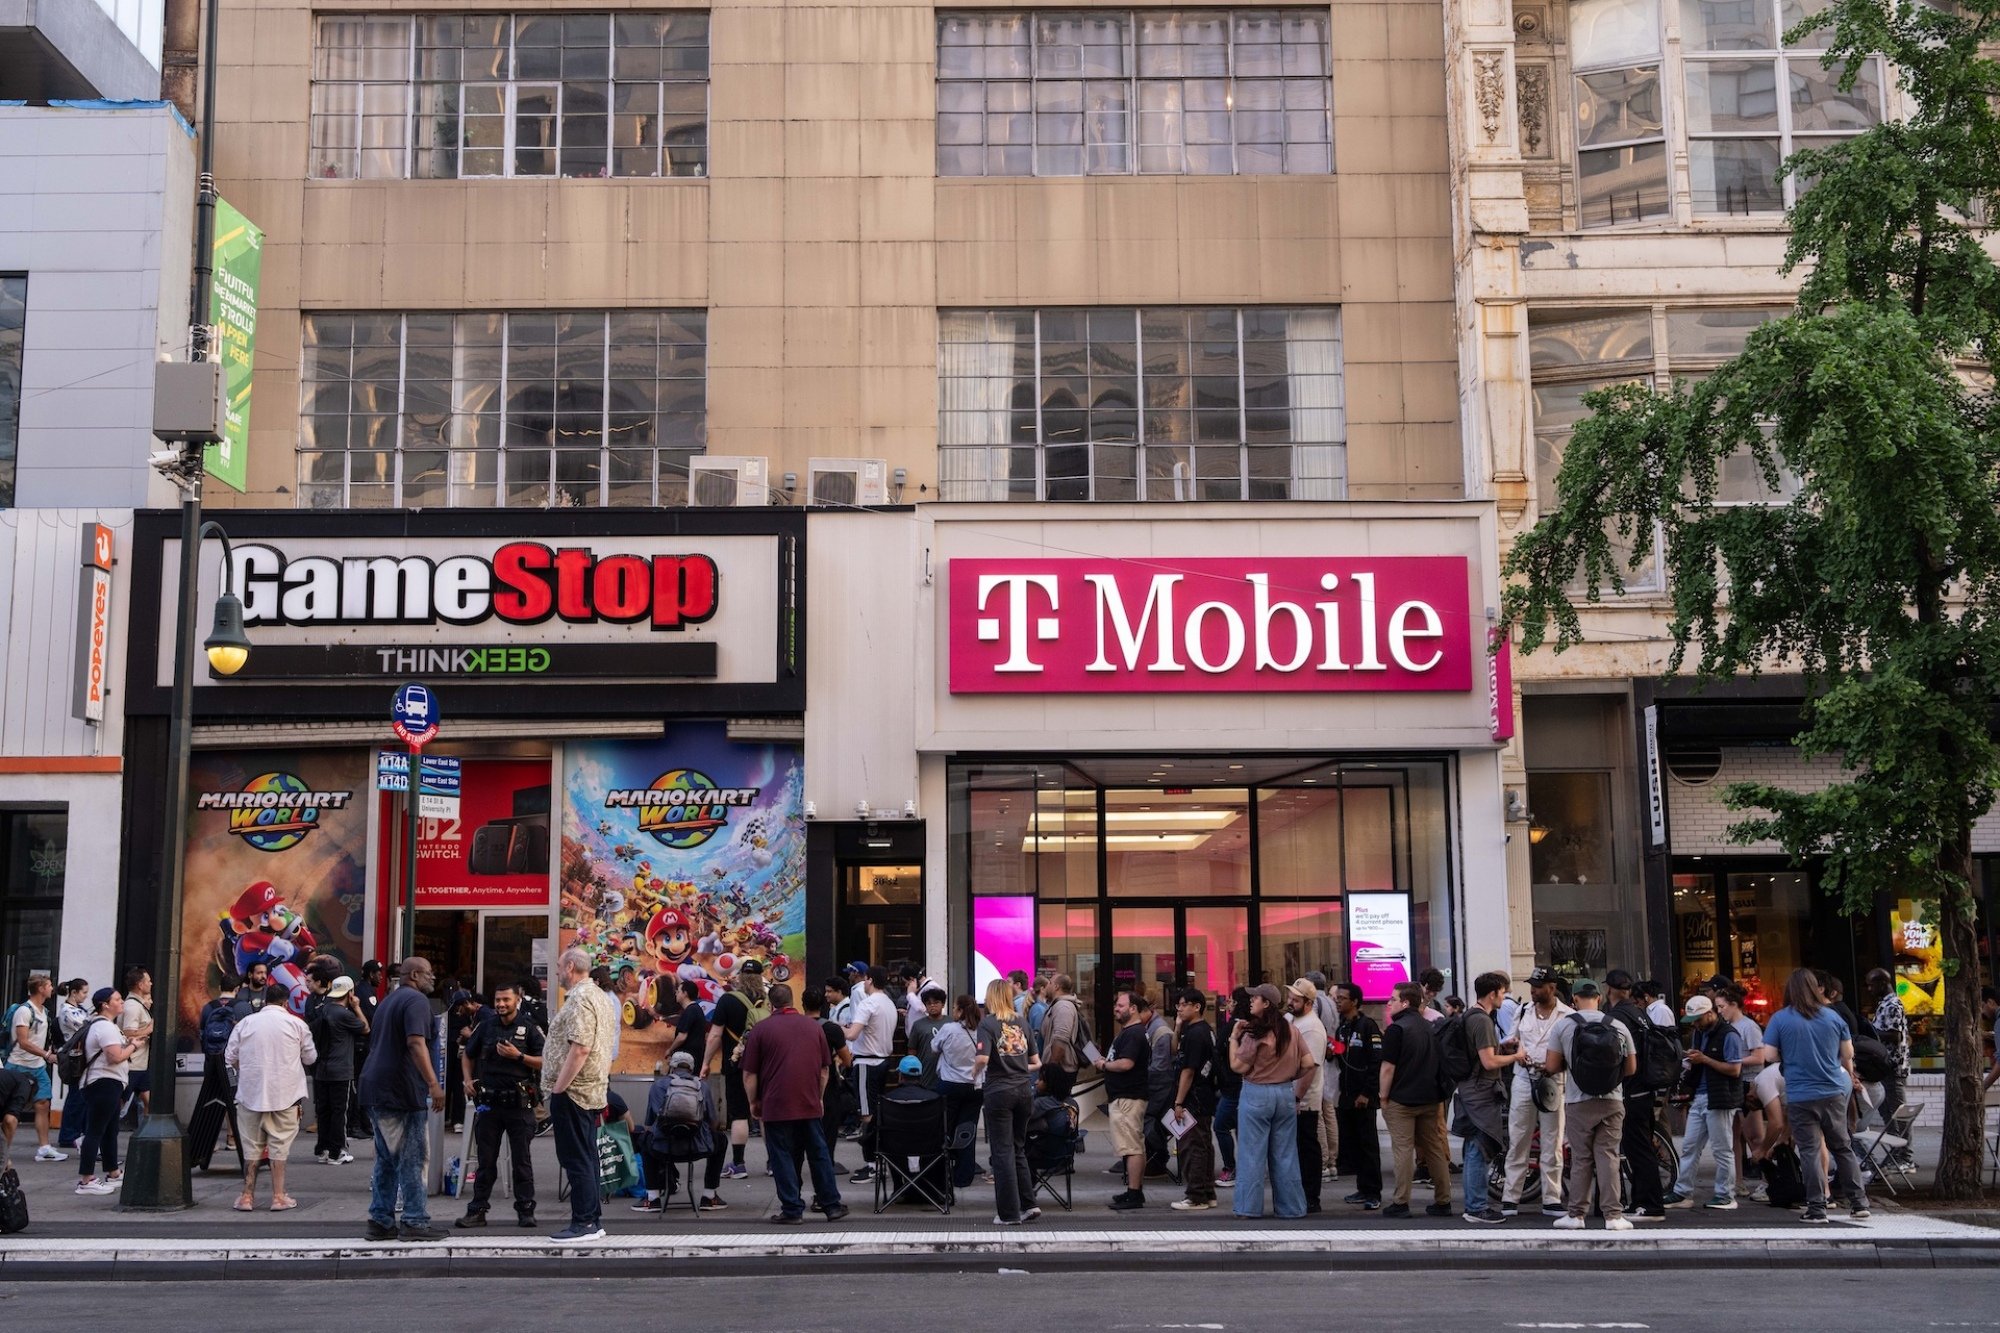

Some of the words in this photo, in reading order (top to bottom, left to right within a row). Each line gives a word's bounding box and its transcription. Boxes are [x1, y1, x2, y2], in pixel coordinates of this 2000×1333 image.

[220, 541, 719, 631] GameStop
[977, 574, 1059, 672] T
[1084, 572, 1444, 674] Mobile
[376, 649, 472, 673] THINK
[396, 724, 407, 737] NO
[406, 727, 437, 743] STANDING
[380, 755, 408, 770] M14A
[423, 757, 437, 765] Lower
[380, 775, 408, 789] M14D
[423, 776, 437, 784] Lower
[438, 777, 448, 785] East
[1651, 758, 1661, 828] LUSH
[231, 808, 318, 828] WORLD
[640, 805, 725, 825] WORLD
[35, 861, 64, 869] OPEN
[473, 887, 504, 895] Anytime,
[1905, 938, 1930, 949] SKIN
